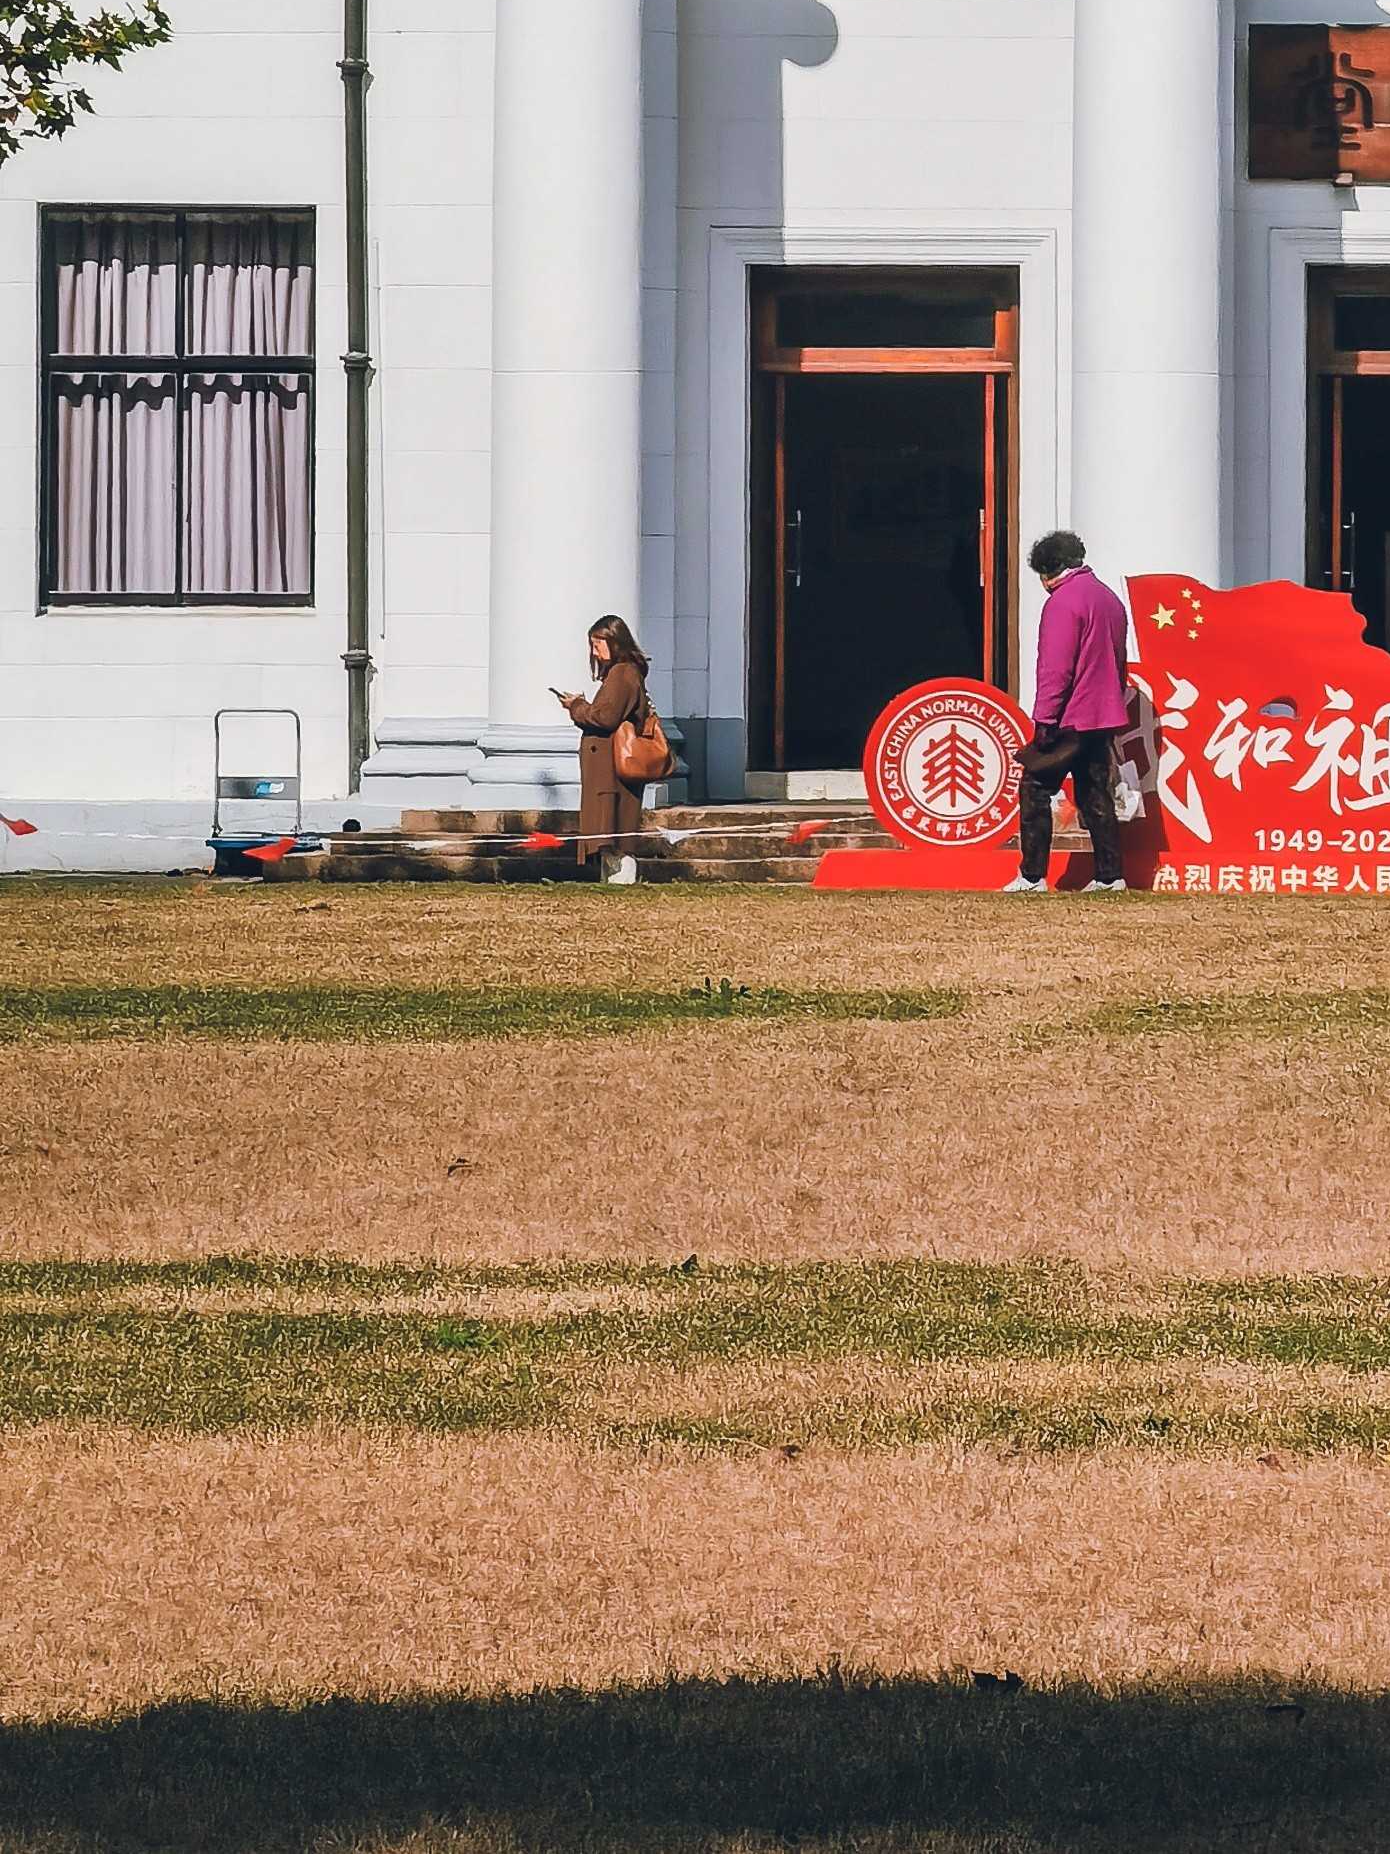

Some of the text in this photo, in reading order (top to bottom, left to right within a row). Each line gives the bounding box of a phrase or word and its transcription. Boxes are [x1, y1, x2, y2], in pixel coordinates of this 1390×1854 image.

[919, 699, 987, 721] NORMAL
[886, 714, 921, 758] CHINA
[884, 761, 905, 801] EAST
